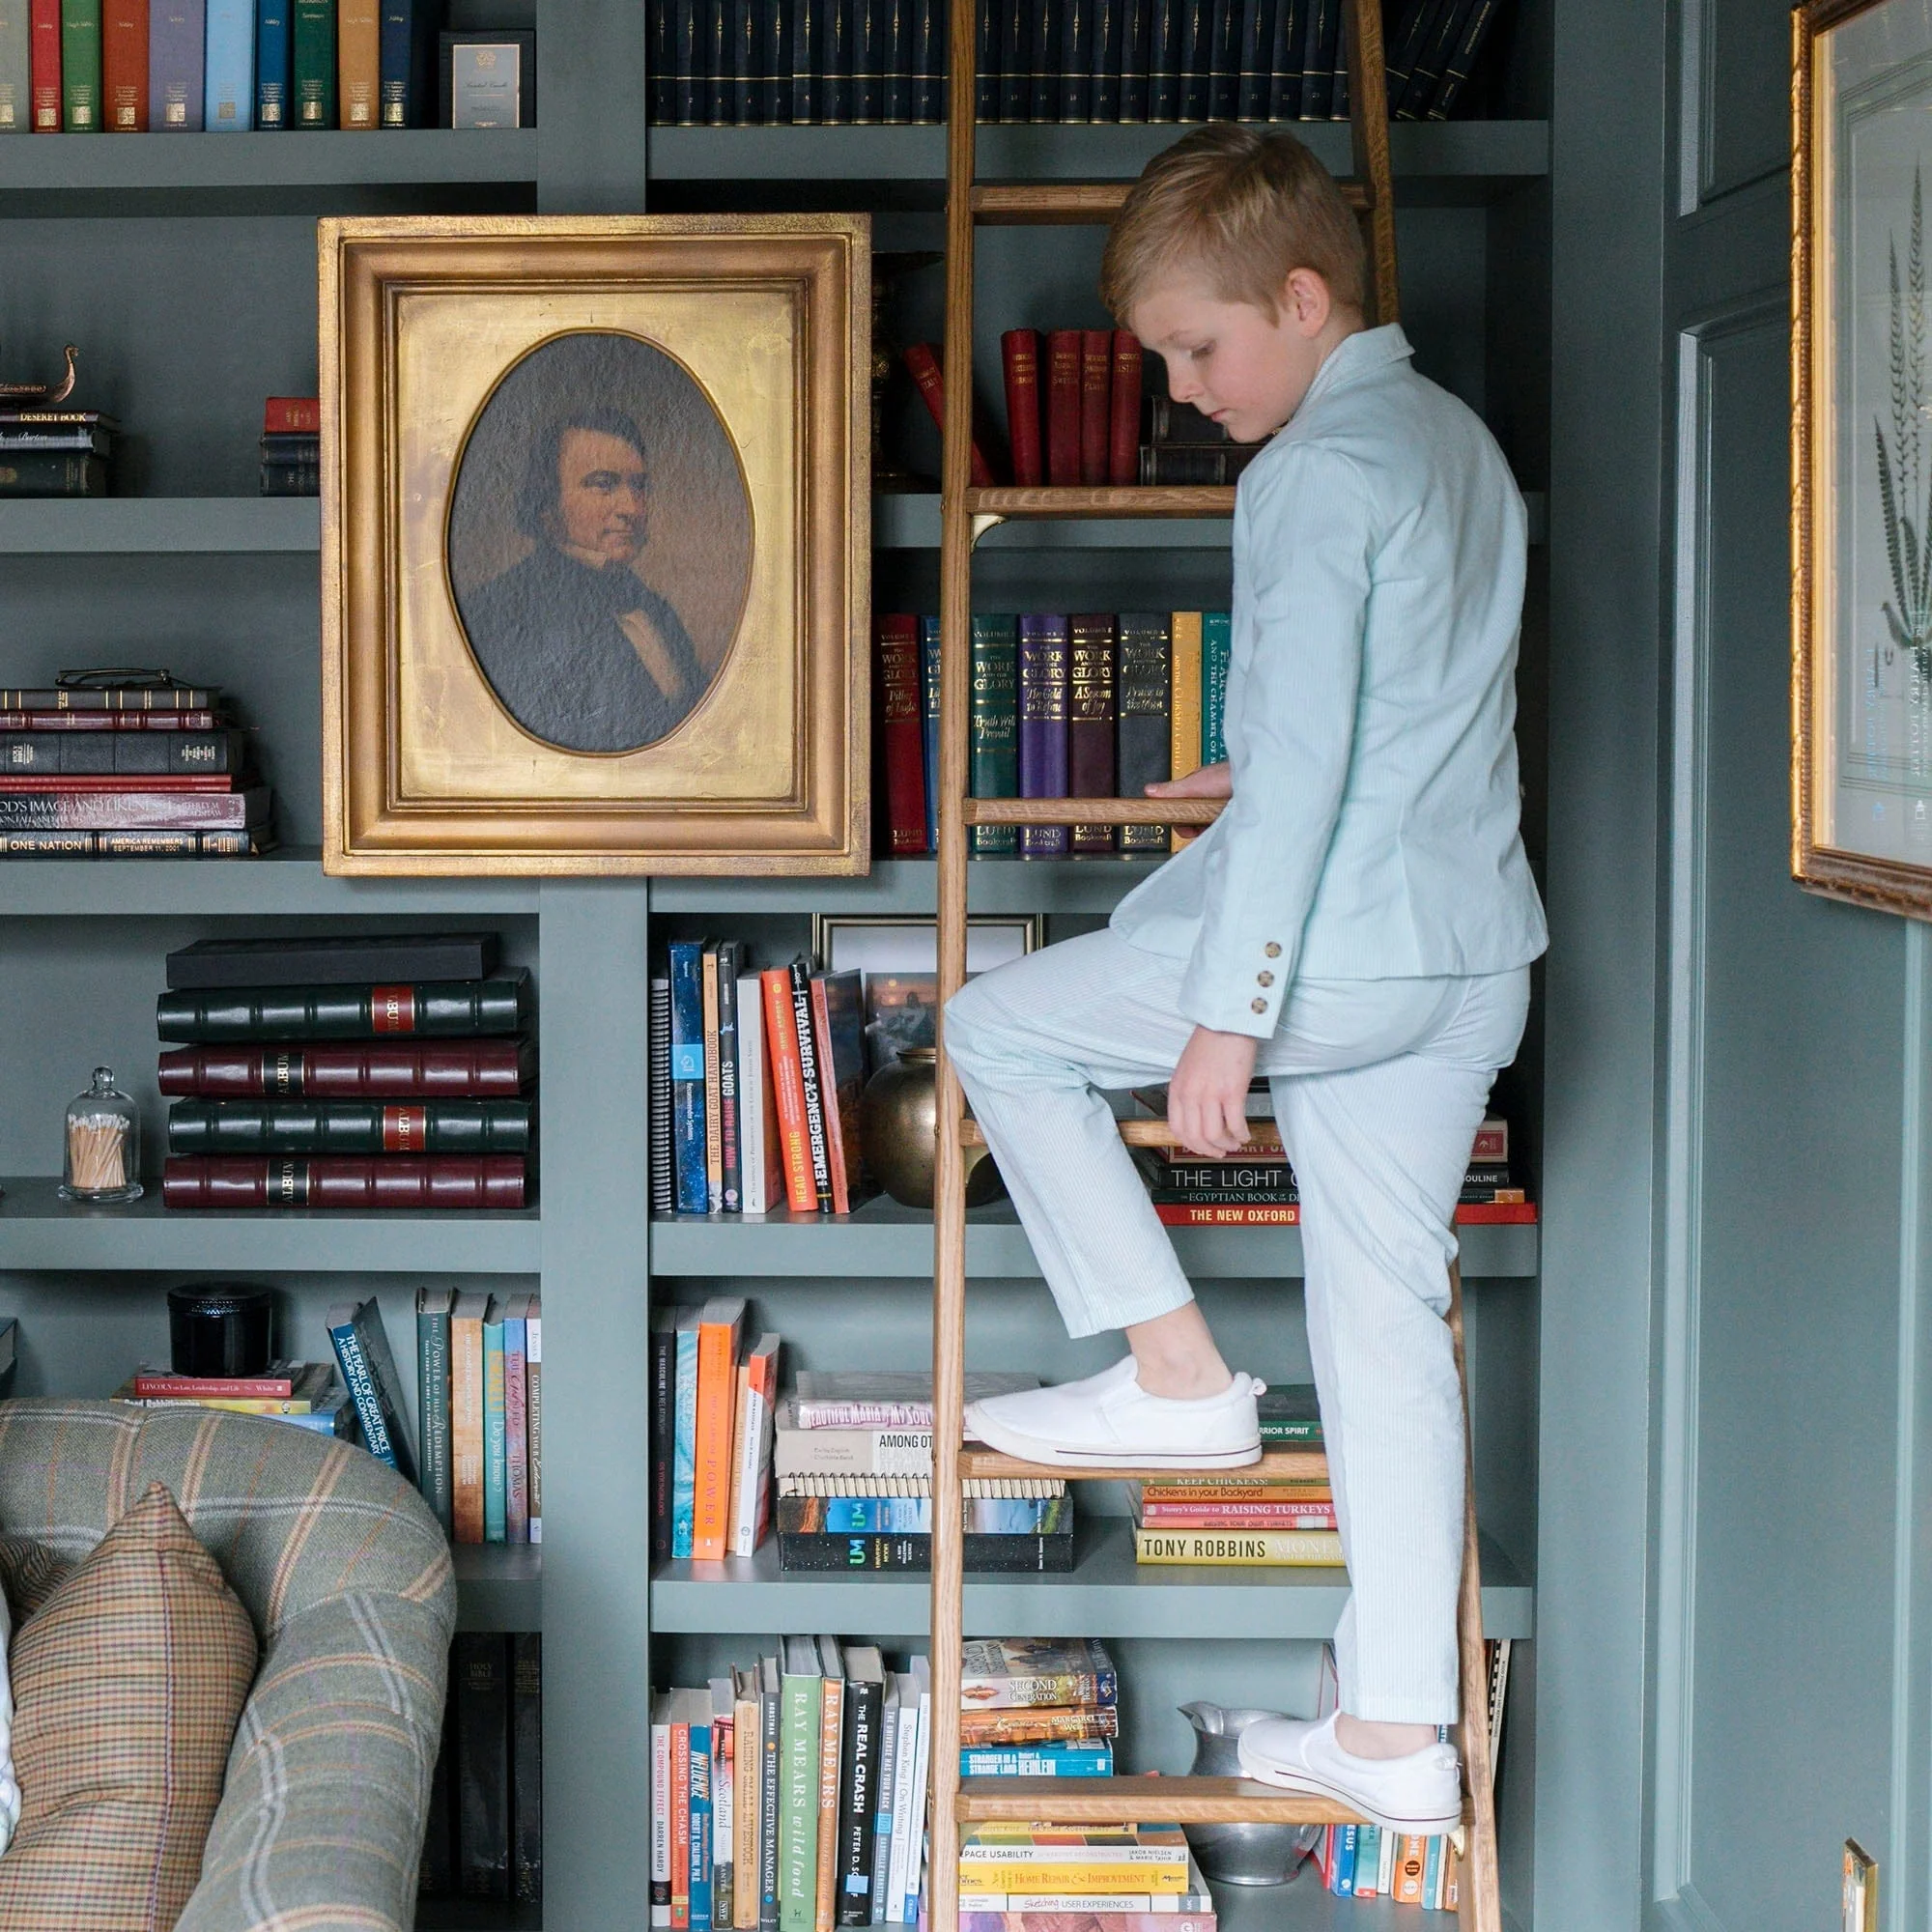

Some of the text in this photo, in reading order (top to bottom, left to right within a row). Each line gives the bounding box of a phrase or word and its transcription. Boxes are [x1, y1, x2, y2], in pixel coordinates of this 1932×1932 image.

[20, 412, 57, 422] DESERET
[1024, 650, 1064, 662] WORK
[1073, 650, 1111, 662] WORK
[1124, 647, 1166, 659] WORK
[976, 661, 1014, 672] WORK
[1022, 668, 1065, 679] GLORY
[1072, 668, 1112, 678] GLORY
[974, 678, 1014, 691] GLORY
[30, 800, 71, 812] IMAGE
[1074, 824, 1111, 834] LUND
[1123, 825, 1164, 837] LUND
[10, 840, 82, 850] ONE NATION
[779, 1032, 788, 1050] DAVE
[277, 1053, 290, 1095] ALBUM
[706, 1030, 721, 1165] THE DAIRY GOAT HANDBOOK
[794, 997, 828, 1180] EMERGENCY SURVIVAL
[722, 1060, 737, 1169] HOW TO RAISE GOATS
[686, 1120, 695, 1141] Systems
[788, 1130, 805, 1172] STRONG
[1170, 1169, 1282, 1187] THE LIGHT
[795, 1176, 808, 1204] HEAD
[1188, 1192, 1277, 1203] EGYPTIAN BOOK
[1189, 1209, 1295, 1222] THE NEW OXFORD
[658, 1357, 667, 1389] MASCULINE
[339, 1345, 381, 1455] HISTORY AND COMMENTARY
[346, 1333, 390, 1454] THE PEARL OF GREAT PRICE
[431, 1335, 445, 1494] POWER REDEMPTION
[811, 1404, 884, 1429] EAUTIFUL MARIA
[490, 1421, 504, 1457] Do you
[879, 1435, 918, 1448] AMONG
[1284, 1426, 1310, 1435] SPIRIT
[511, 1454, 522, 1499] THOMAS
[704, 1460, 717, 1525] POWER
[1147, 1488, 1264, 1498] Chickens in your Backyard
[851, 1502, 867, 1527] UM
[1162, 1505, 1188, 1515] Storey's
[1189, 1505, 1209, 1514] Guide
[1222, 1504, 1271, 1514] RAISING
[1274, 1504, 1330, 1514] TURKEYS
[849, 1539, 867, 1564] UM
[1144, 1539, 1265, 1557] TONY ROBBINS
[1008, 1679, 1058, 1691] SECOND
[1009, 1690, 1058, 1702] GENERATION
[743, 1730, 754, 1773] RAISING
[821, 1694, 838, 1809] RAY MEARS
[881, 1711, 895, 1809] THE UNIVERSE HAS YOUR BACK
[969, 1753, 1002, 1765] STRANGER
[690, 1749, 710, 1801] INFLUENCE
[895, 1723, 913, 1834] Stephen King On Writing
[969, 1764, 1017, 1775] STRANGE LAND
[678, 1728, 688, 1845] CROSSING THE CHASM
[791, 1692, 808, 1898] RAY MEARS wild food
[851, 1704, 868, 1865] THE REAL CRASH PETER D.
[656, 1735, 665, 1873] THE COMPOUND EFFECT DARREN HARDY
[718, 1779, 731, 1829] Scotland
[691, 1812, 701, 1834] ROBERT
[764, 1751, 776, 1893] THE EFFECTIVE MANAGER
[742, 1811, 753, 1865] LIVESTOCK
[1345, 1824, 1355, 1851] ESUS
[989, 1850, 1034, 1859] USABILITY
[1014, 1872, 1146, 1885] HOME REPAIR IMPROVEMENT
[1024, 1898, 1134, 1911] Sketching USER EXPERIENCES
